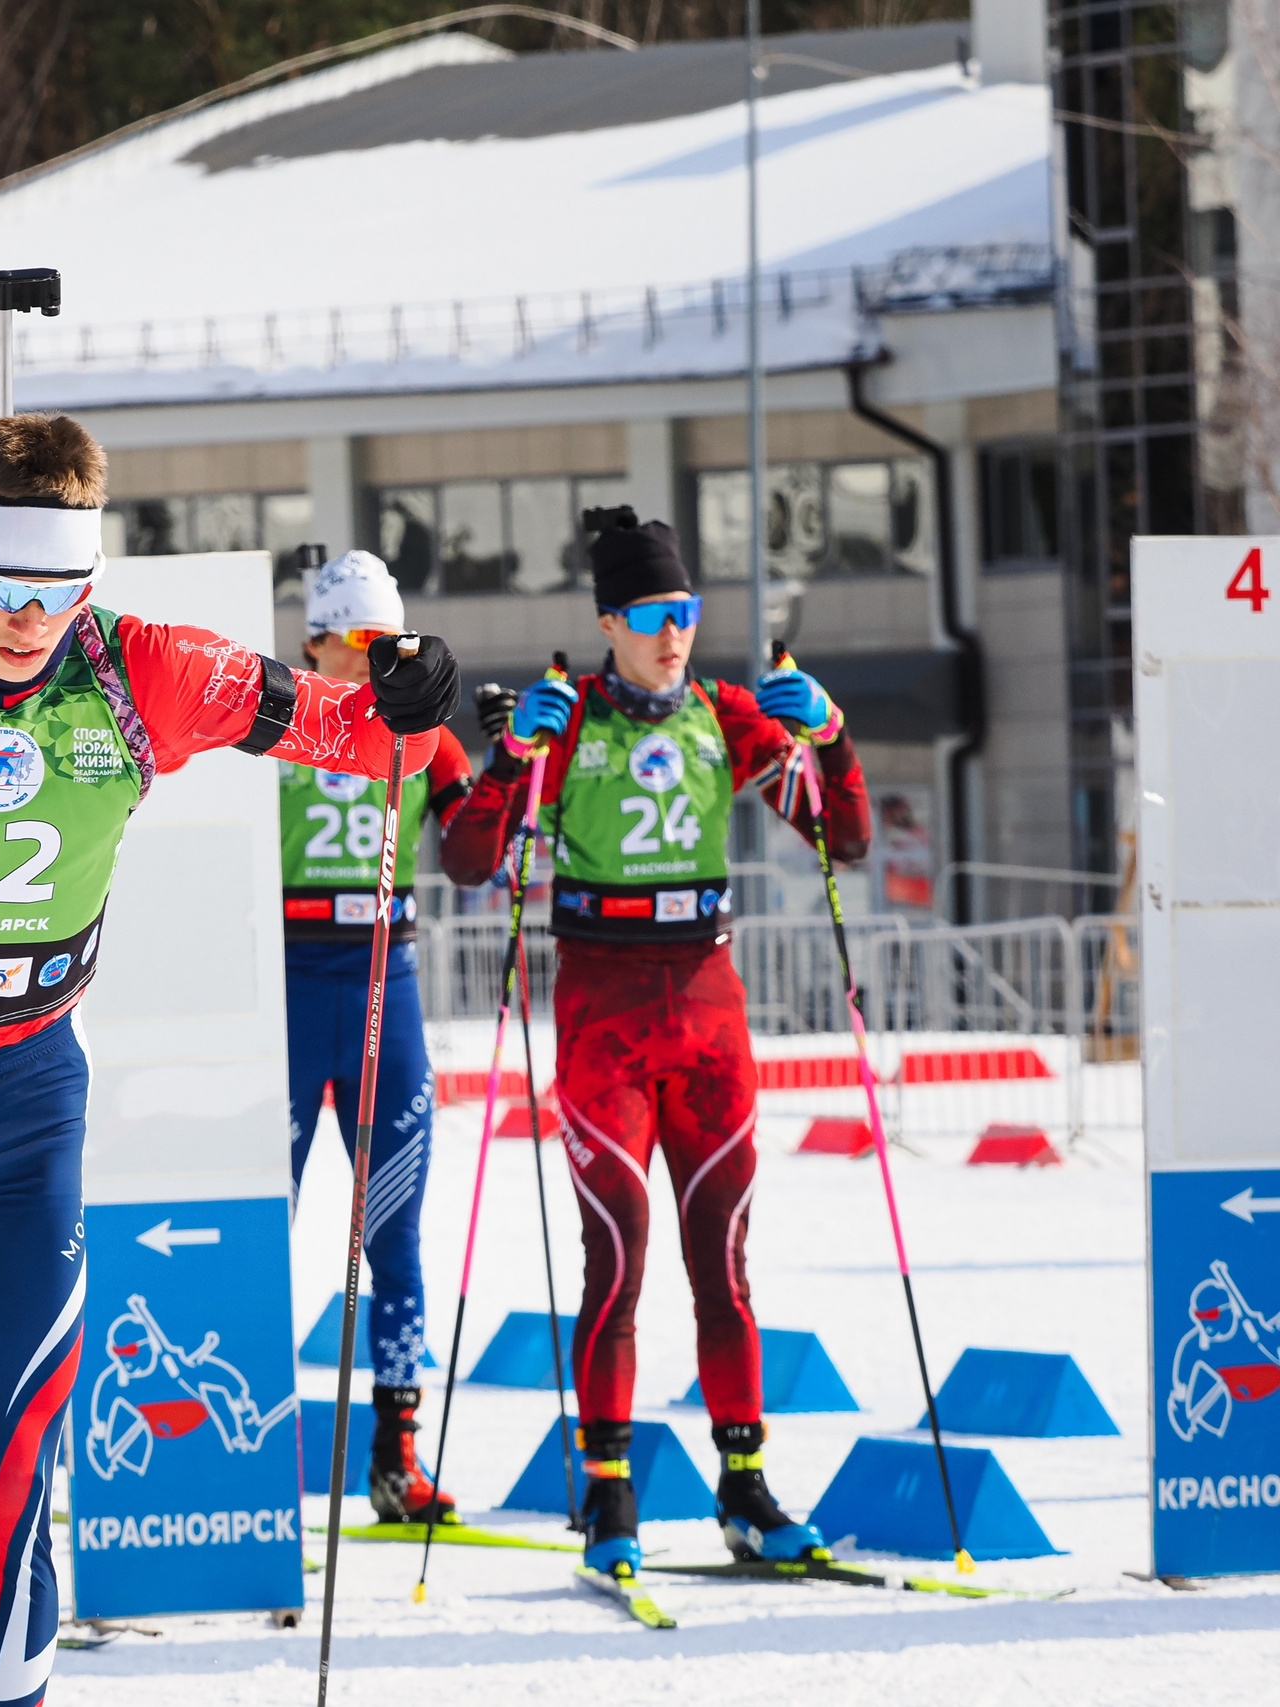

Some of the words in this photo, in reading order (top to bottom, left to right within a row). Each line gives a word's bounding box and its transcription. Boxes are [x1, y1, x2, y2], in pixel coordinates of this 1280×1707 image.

[1225, 547, 1270, 613] 4
[16, 731, 38, 751] РОССИИ
[72, 727, 114, 742] СПОРТ
[72, 741, 122, 756] НОРМА
[73, 754, 123, 769] ЖИЗНИ
[73, 776, 100, 784] ПРОЕКТ
[305, 803, 385, 859] 28
[620, 794, 701, 856] 24
[377, 803, 398, 929] SWIX
[371, 981, 381, 1012] TRIAC
[367, 1027, 377, 1058] AERO
[1157, 1474, 1280, 1510] КРАСНО
[77, 1508, 298, 1551] КРАСНОЯРСК
